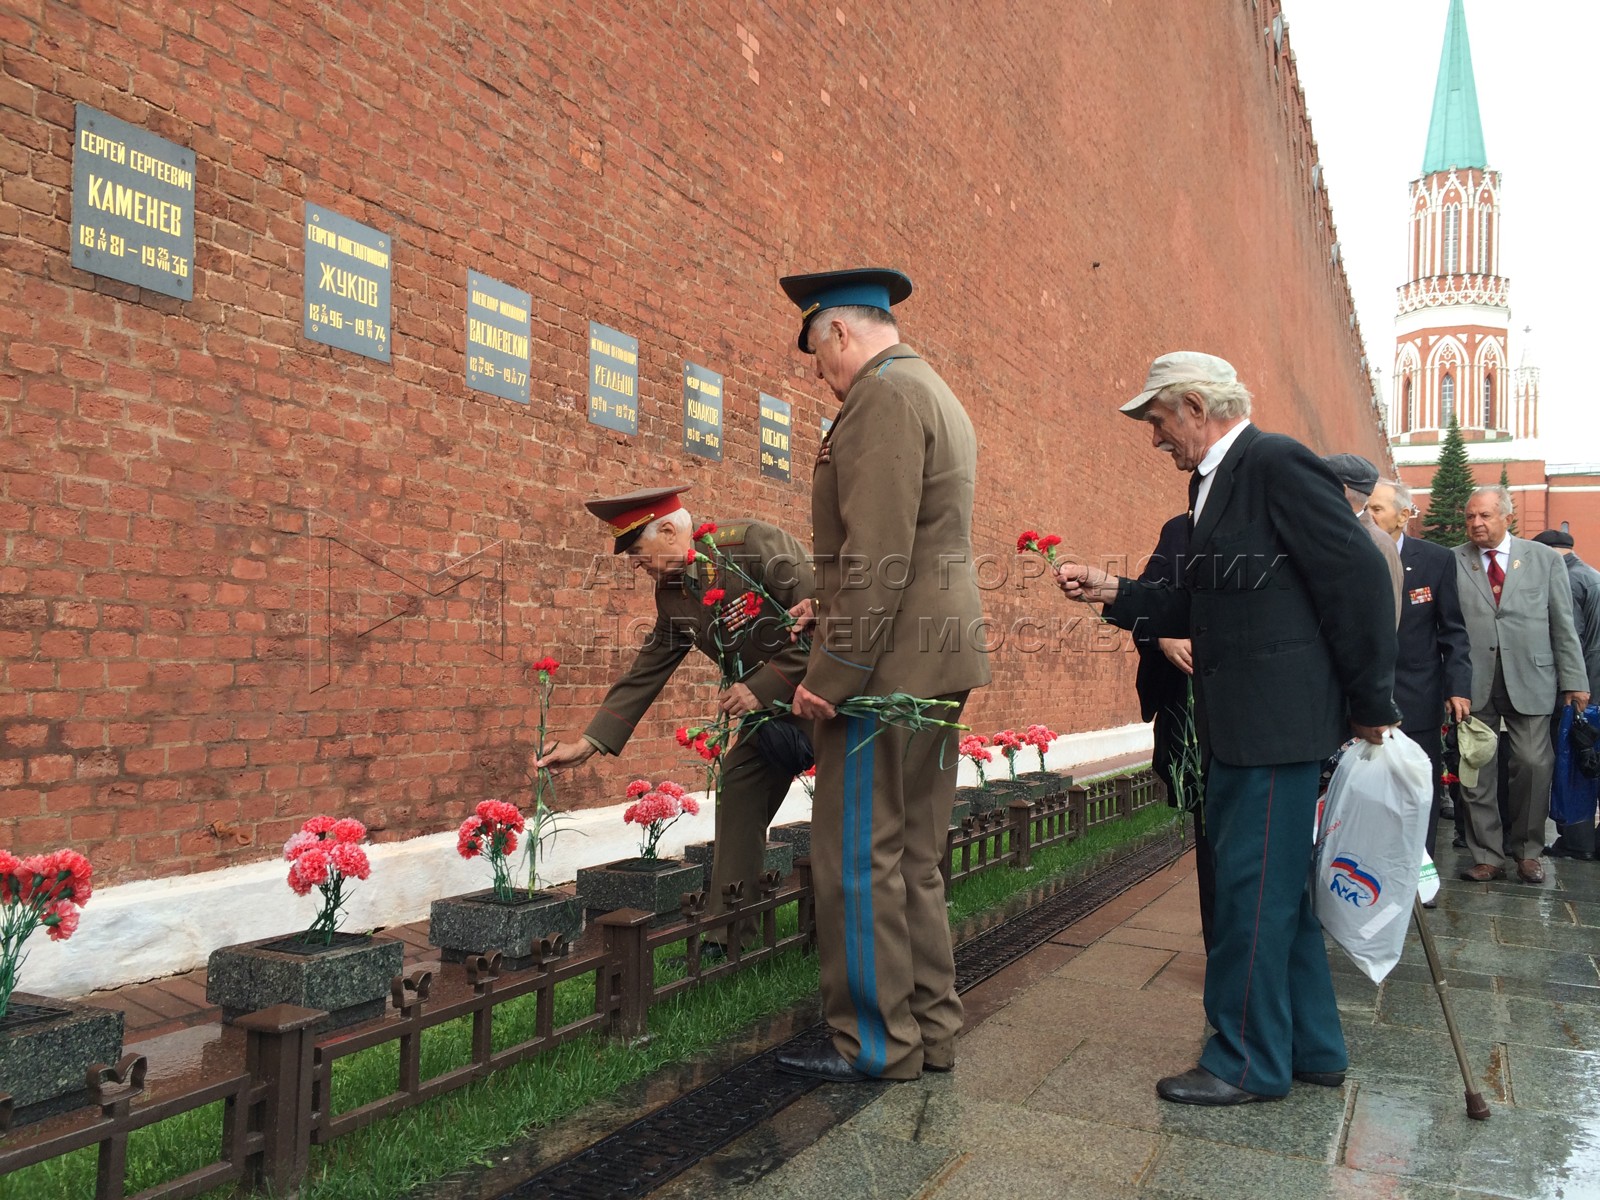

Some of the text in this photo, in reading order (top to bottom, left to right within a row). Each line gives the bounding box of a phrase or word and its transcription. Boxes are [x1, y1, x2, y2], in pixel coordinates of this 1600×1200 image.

[80, 129, 192, 191] СЕРГЕЙ СЕРГЕЕВИЧ
[88, 173, 182, 237] КАМЕНЕВ
[319, 261, 378, 308] ЖУКОВ
[469, 318, 528, 360] ВАСИЛЕВСКИЙ
[687, 398, 719, 426] КУЛАКОВ
